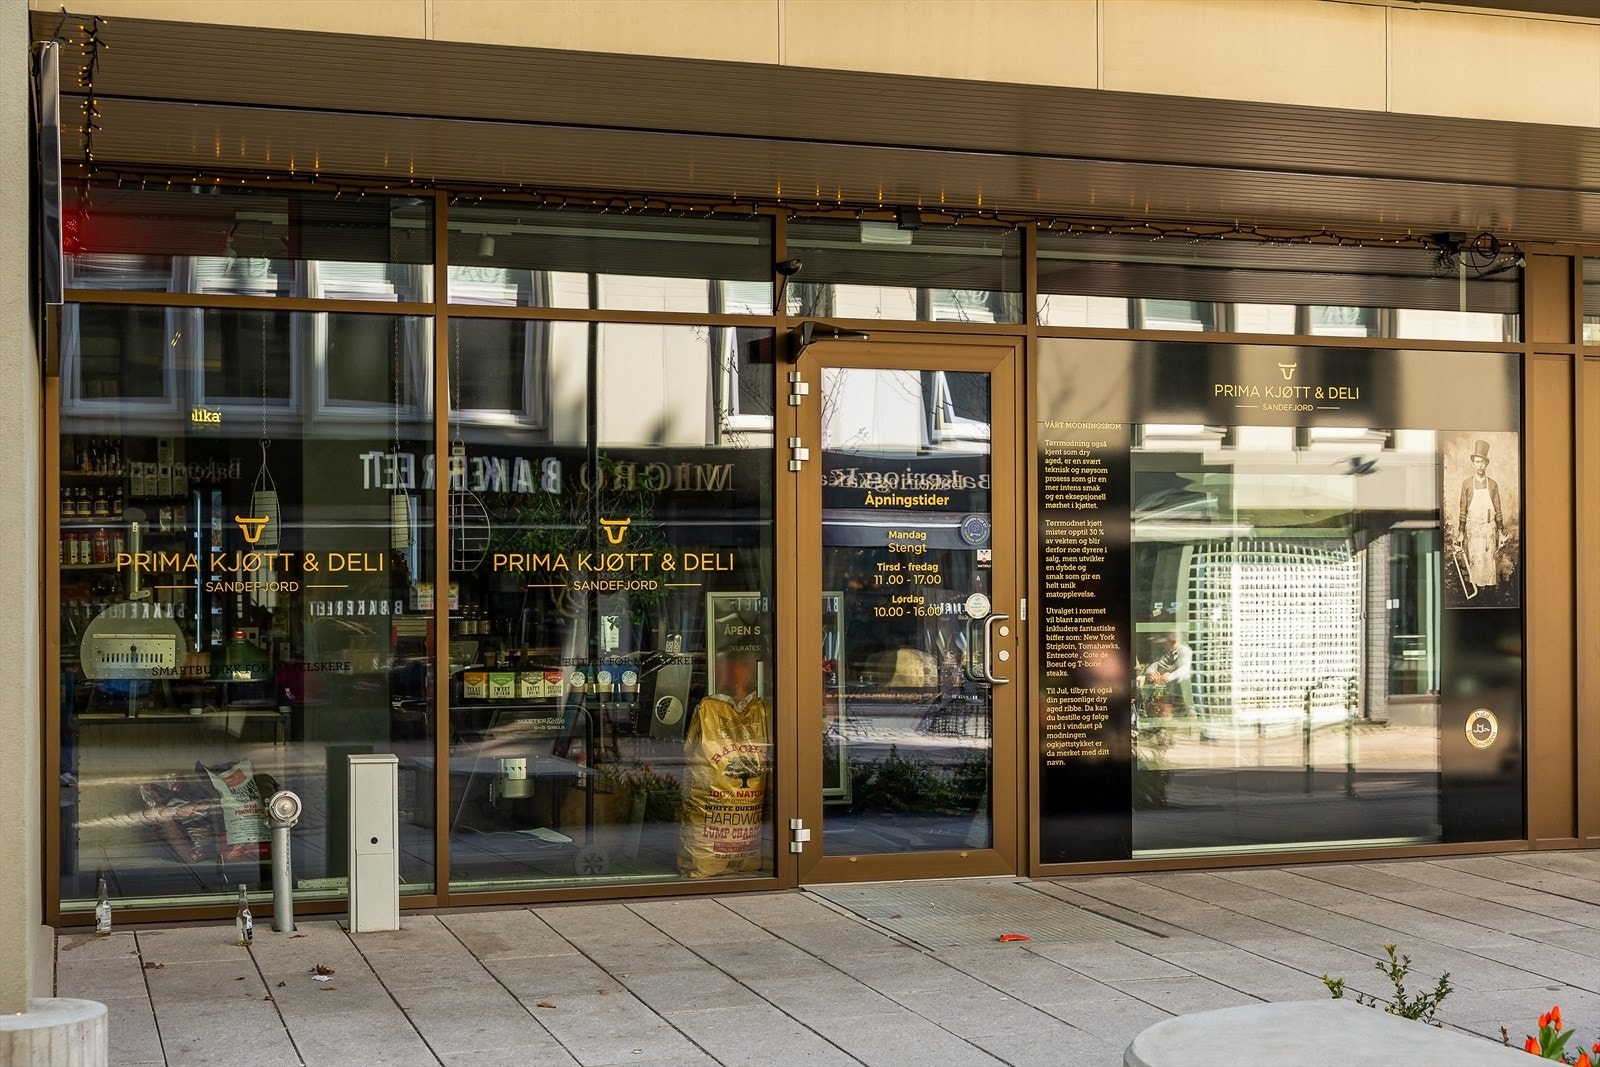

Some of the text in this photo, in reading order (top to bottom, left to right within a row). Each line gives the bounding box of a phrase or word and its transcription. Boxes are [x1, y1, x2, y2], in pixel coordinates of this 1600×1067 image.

[1214, 384, 1360, 400] PRIMA KJØTT & DELI
[1262, 403, 1314, 412] SANDEFJORD
[864, 490, 950, 508] Åpningstider
[888, 530, 926, 540] Mandag
[888, 542, 928, 554] Stengt
[116, 552, 384, 572] PRIMA KJØTT & DELI
[494, 552, 734, 572] PRIMA KJØTT & DELI
[876, 562, 900, 572] Tirsd
[908, 562, 939, 573] fredag
[573, 580, 658, 592] SANDEFJORD
[914, 575, 942, 585] 17.00
[206, 581, 300, 593] SANDEFJORD
[892, 595, 925, 606] Lørdag
[874, 607, 904, 617] 10.00
[914, 607, 942, 617] 16.00
[724, 624, 751, 635] ÅPEN
[703, 826, 730, 839] LUMP
